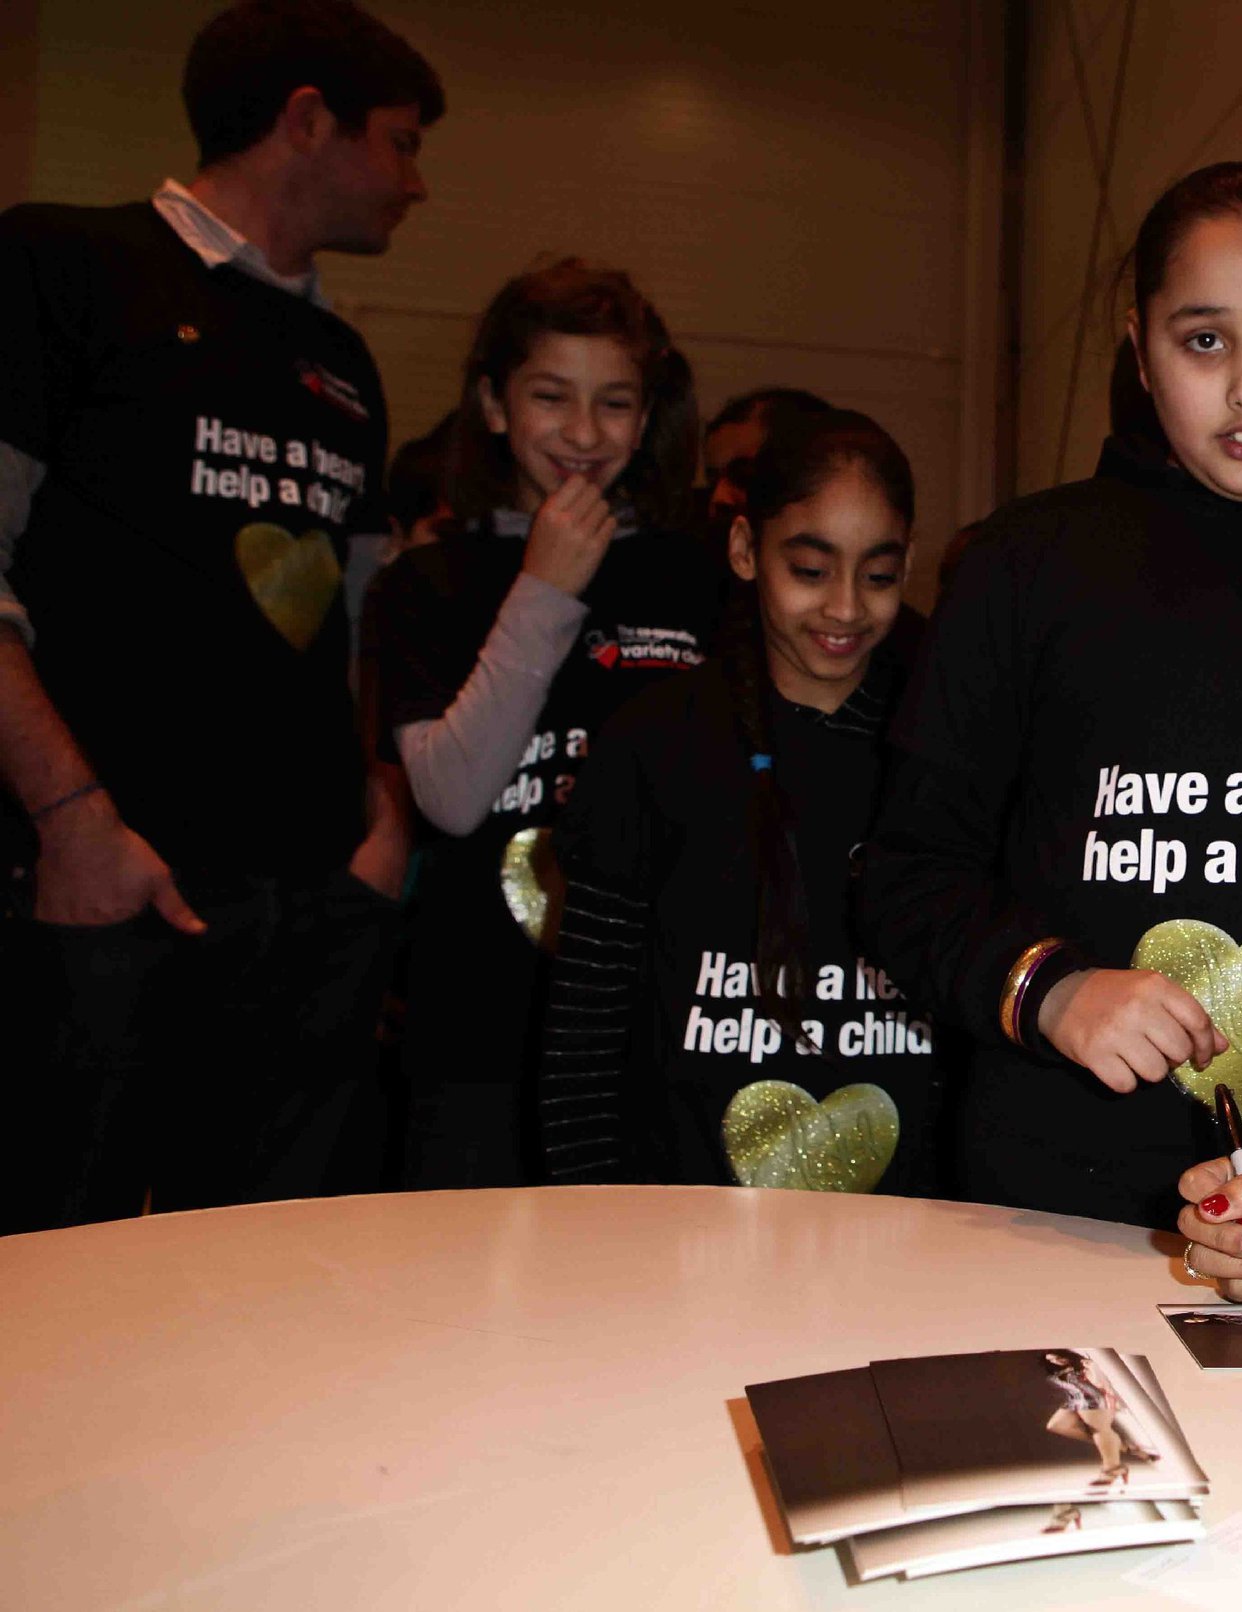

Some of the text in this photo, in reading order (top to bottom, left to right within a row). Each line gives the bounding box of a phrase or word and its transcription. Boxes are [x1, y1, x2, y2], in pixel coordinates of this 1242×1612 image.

[195, 415, 277, 463] Have
[286, 440, 307, 468] a
[191, 459, 271, 508] help
[278, 477, 300, 504] a
[620, 643, 681, 663] variety
[566, 728, 588, 758] a
[492, 772, 544, 813] elp
[1094, 764, 1209, 818] Have
[1082, 828, 1187, 894] help
[1204, 840, 1237, 883] a
[816, 964, 844, 1000] a
[683, 1005, 782, 1063] help
[795, 1020, 824, 1055] a
